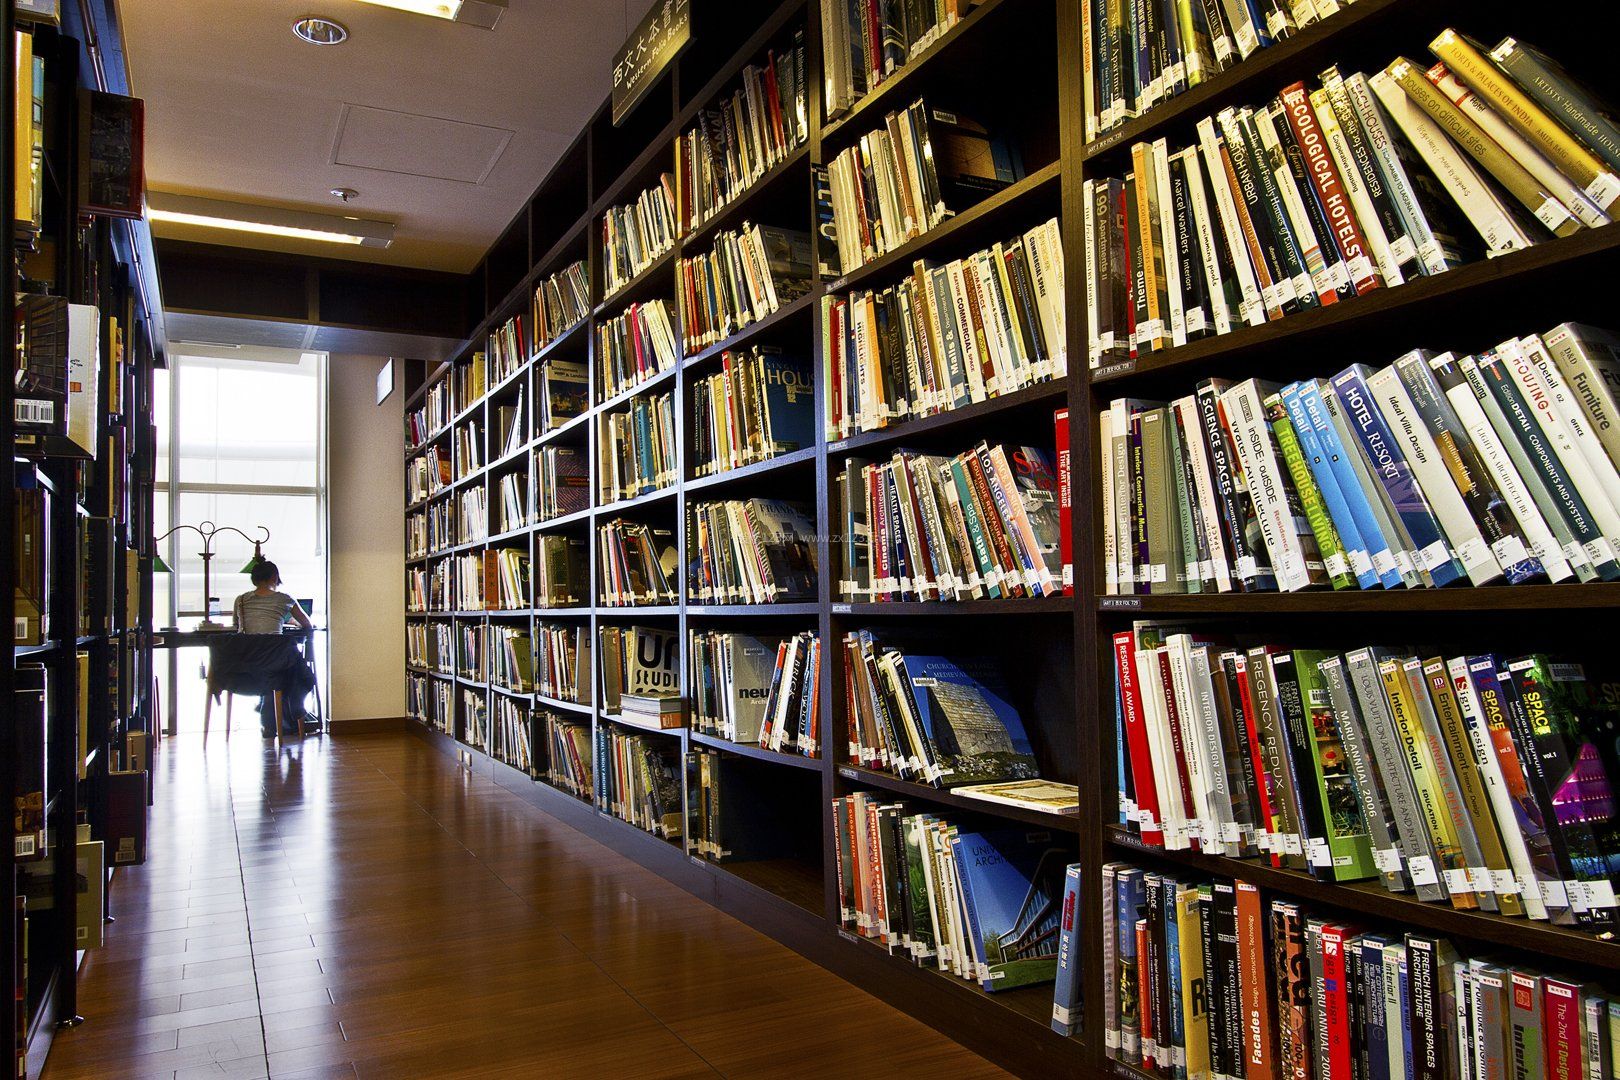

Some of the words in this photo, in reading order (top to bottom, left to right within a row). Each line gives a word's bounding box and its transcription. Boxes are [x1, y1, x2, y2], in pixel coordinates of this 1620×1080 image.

[626, 58, 652, 90] Western
[652, 40, 667, 59] Folio
[667, 13, 688, 41] Books
[1098, 17, 1110, 61] Cottages
[1402, 74, 1430, 103] houses
[1427, 99, 1441, 114] on
[1438, 109, 1471, 145] difficult
[1466, 135, 1488, 156] sites
[1450, 47, 1470, 71] FORTS
[1469, 64, 1478, 75] &
[1476, 72, 1504, 101] PALACES
[1502, 94, 1515, 107] OF
[1511, 101, 1534, 127] INDIA
[1552, 140, 1569, 159] BAIG
[1469, 96, 1486, 113] Hotel
[1532, 76, 1564, 103] ARTISTS'
[1562, 99, 1599, 136] Handmade
[1347, 119, 1359, 134] the
[1352, 132, 1363, 146] for
[1289, 88, 1332, 194] ECOLOGICAL
[1326, 193, 1363, 258] HOTELS
[1332, 134, 1348, 169] Cooperative
[1346, 168, 1358, 193] housing
[1356, 145, 1384, 196] RESIDENCES
[1096, 194, 1107, 216] 99
[1238, 167, 1259, 204] URBAN
[1251, 130, 1259, 149] The
[1255, 149, 1265, 170] Great
[1261, 168, 1275, 198] Family
[1270, 195, 1284, 227] Houses
[1278, 227, 1289, 236] of
[1284, 237, 1297, 266] Europe
[1099, 219, 1107, 266] Apartments
[1178, 213, 1190, 254] wanders
[1201, 224, 1212, 263] swimming
[951, 271, 961, 296] FEATURE
[971, 265, 986, 309] COMMERCE
[1027, 235, 1043, 276] COMMERCIAL
[1036, 276, 1047, 298] SPACE
[1183, 258, 1191, 291] Interiors
[1206, 264, 1219, 287] pools
[1137, 270, 1146, 311] Theme
[944, 329, 954, 340] &
[954, 297, 973, 353] COMMERCIAL
[855, 321, 865, 384] HIGHLIGHTS
[946, 340, 960, 375] Malls
[967, 353, 975, 372] SPACE
[1463, 367, 1490, 400] housing
[1536, 361, 1558, 389] Detail
[1554, 393, 1564, 403] 02
[1569, 417, 1585, 438] OFFICE
[1562, 346, 1578, 366] D&D
[1572, 371, 1613, 431] Furniture
[1323, 394, 1340, 417] house
[1343, 386, 1376, 432] HOTEL
[1365, 430, 1401, 482] RESORT
[1387, 394, 1405, 417] Ideal
[1398, 415, 1414, 435] Villa
[1406, 433, 1428, 465] Design
[1115, 442, 1126, 477] Design
[1134, 446, 1142, 474] Interiors
[1201, 397, 1222, 448] SCIENCE
[1213, 449, 1233, 495] SPACES
[1225, 498, 1241, 538] ARCHITECTURE
[875, 474, 885, 525] Architecture
[889, 484, 898, 513] HEALTH
[979, 452, 994, 475] LOS
[987, 475, 1012, 523] ANGELES
[1003, 482, 1023, 517] DESIGN
[1116, 479, 1127, 515] Interior
[1135, 476, 1144, 516] Construction
[1528, 433, 1561, 484] COMPONENTS
[1555, 481, 1571, 502] AND
[1564, 498, 1589, 534] SYSTEMS
[892, 514, 901, 544] SPACES
[964, 501, 980, 525] Spa
[970, 460, 988, 499] BOUTIQUE
[984, 499, 1008, 558] RESTAURANTS
[970, 523, 980, 534] &
[1137, 517, 1146, 542] Manual
[878, 528, 889, 570] Cinema
[948, 504, 971, 558] Restaurant
[973, 534, 990, 564] Bath
[787, 659, 800, 698] BRICK
[1119, 644, 1130, 688] RESIDENCE
[1126, 689, 1134, 723] AWARD
[1199, 691, 1214, 733] INTERIOR
[1250, 659, 1274, 733] REGENCY
[1266, 735, 1284, 790] REDUX
[1454, 679, 1476, 713] Sign
[1466, 715, 1491, 765] Design
[1482, 688, 1505, 731] SPACE
[1206, 733, 1219, 768] DESIGN
[1389, 691, 1412, 737] Interior
[1404, 735, 1423, 770] Detail
[1437, 691, 1470, 771] Entertainment
[1339, 710, 1355, 741] MARU
[1349, 742, 1368, 786] ANNUAL
[1361, 788, 1377, 818] 2006
[1360, 675, 1374, 700] LOUIS
[1367, 700, 1387, 740] VUITTON
[1379, 739, 1406, 805] ARCHITECTURE
[1399, 805, 1413, 828] AND
[1213, 770, 1224, 795] 2007
[1462, 771, 1474, 794] Interior
[1421, 788, 1438, 830] EDUCATION
[1467, 794, 1481, 819] Design
[847, 809, 856, 857] GUGGENHEIM
[869, 812, 878, 863] Universities
[874, 863, 880, 872] &
[875, 873, 884, 910] Colleges
[1201, 906, 1209, 916] The
[1247, 914, 1255, 945] Technology
[1204, 936, 1212, 967] Beautiful
[1249, 947, 1257, 984] Construction,
[1421, 951, 1430, 987] FRENCH
[1205, 969, 1213, 994] Villages
[1226, 959, 1238, 1020] PRE-COLUMBIAN
[1315, 976, 1325, 1007] MARU
[1412, 949, 1422, 1017] ARCHITECTURE
[1317, 1008, 1328, 1052] ANNUAL
[1423, 988, 1433, 1031] INTERIOR
[1557, 1002, 1566, 1019] The
[1557, 1020, 1567, 1040] 2nd
[1210, 1031, 1217, 1039] of
[1231, 1025, 1242, 1076] ARCHITECTURE
[1249, 1010, 1262, 1065] Facades
[1425, 1031, 1434, 1068] SPACES
[1555, 1049, 1568, 1080] Design
